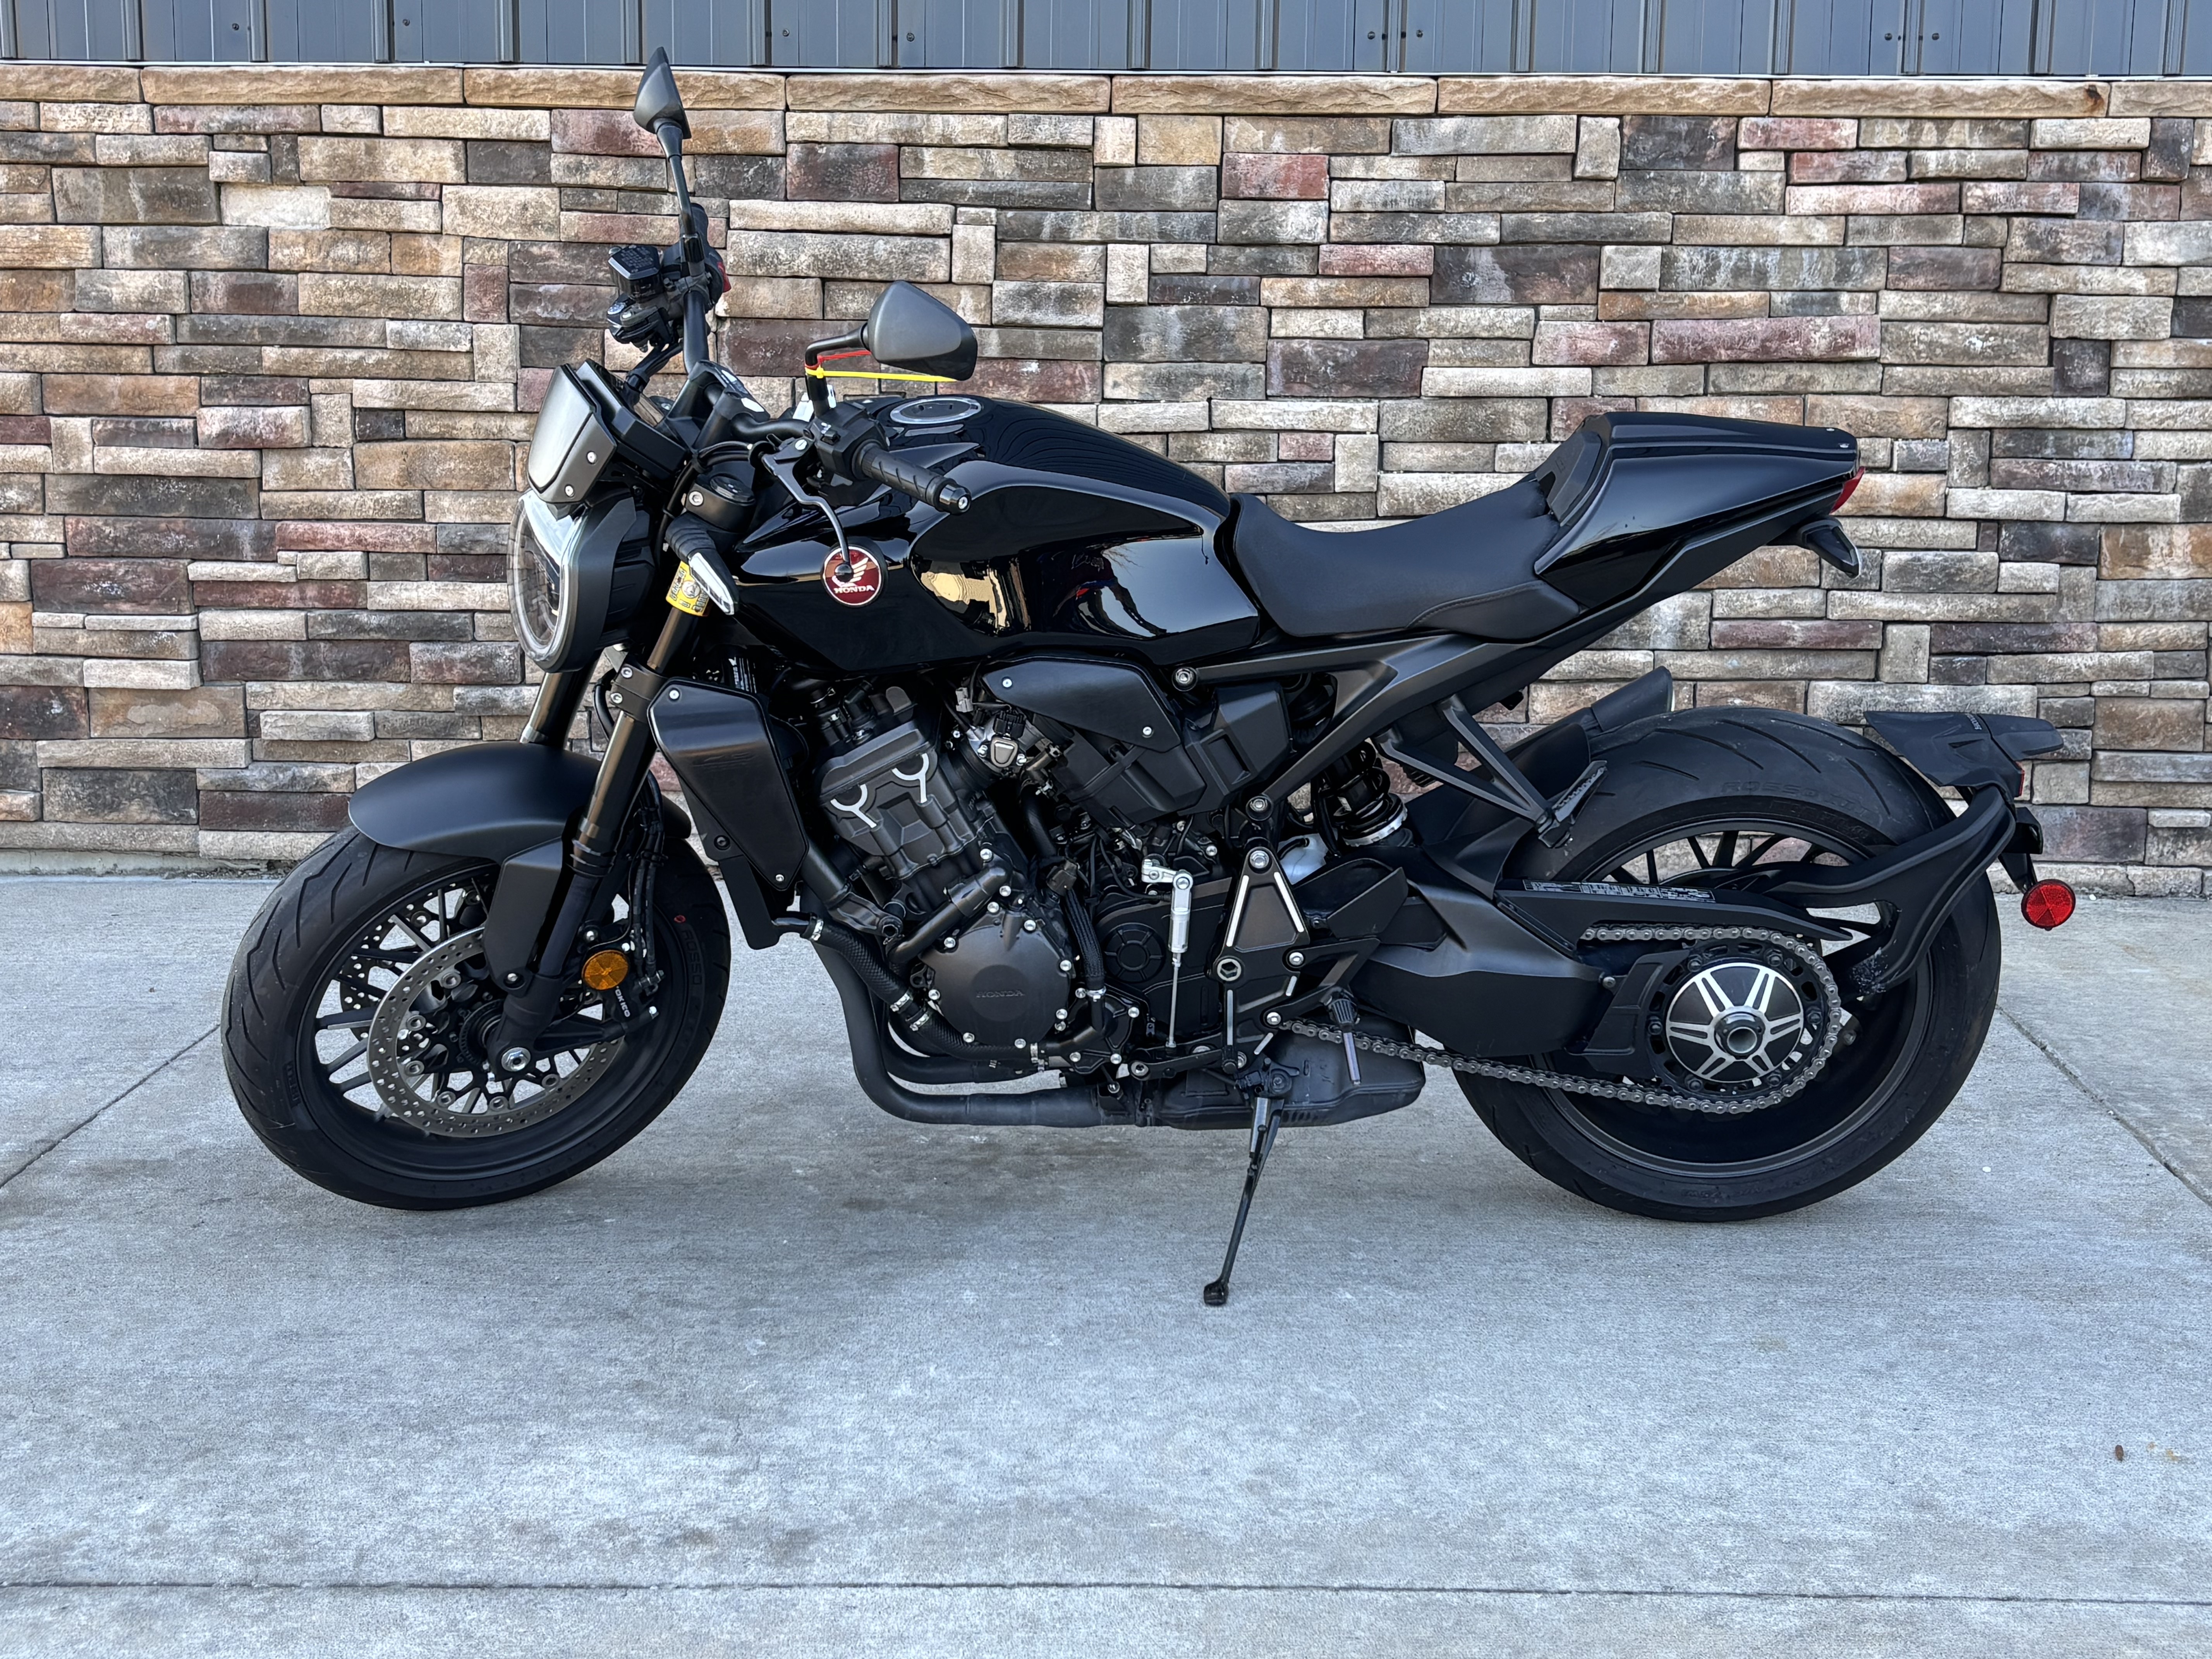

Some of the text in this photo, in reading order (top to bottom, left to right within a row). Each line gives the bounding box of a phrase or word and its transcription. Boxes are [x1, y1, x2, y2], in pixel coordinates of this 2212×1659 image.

[834, 585, 875, 594] HONDA
[1721, 781, 1820, 797] ROSSO
[682, 930, 702, 985] ROSSO
[615, 986, 630, 1017] OKICO
[976, 989, 1025, 998] HONDA
